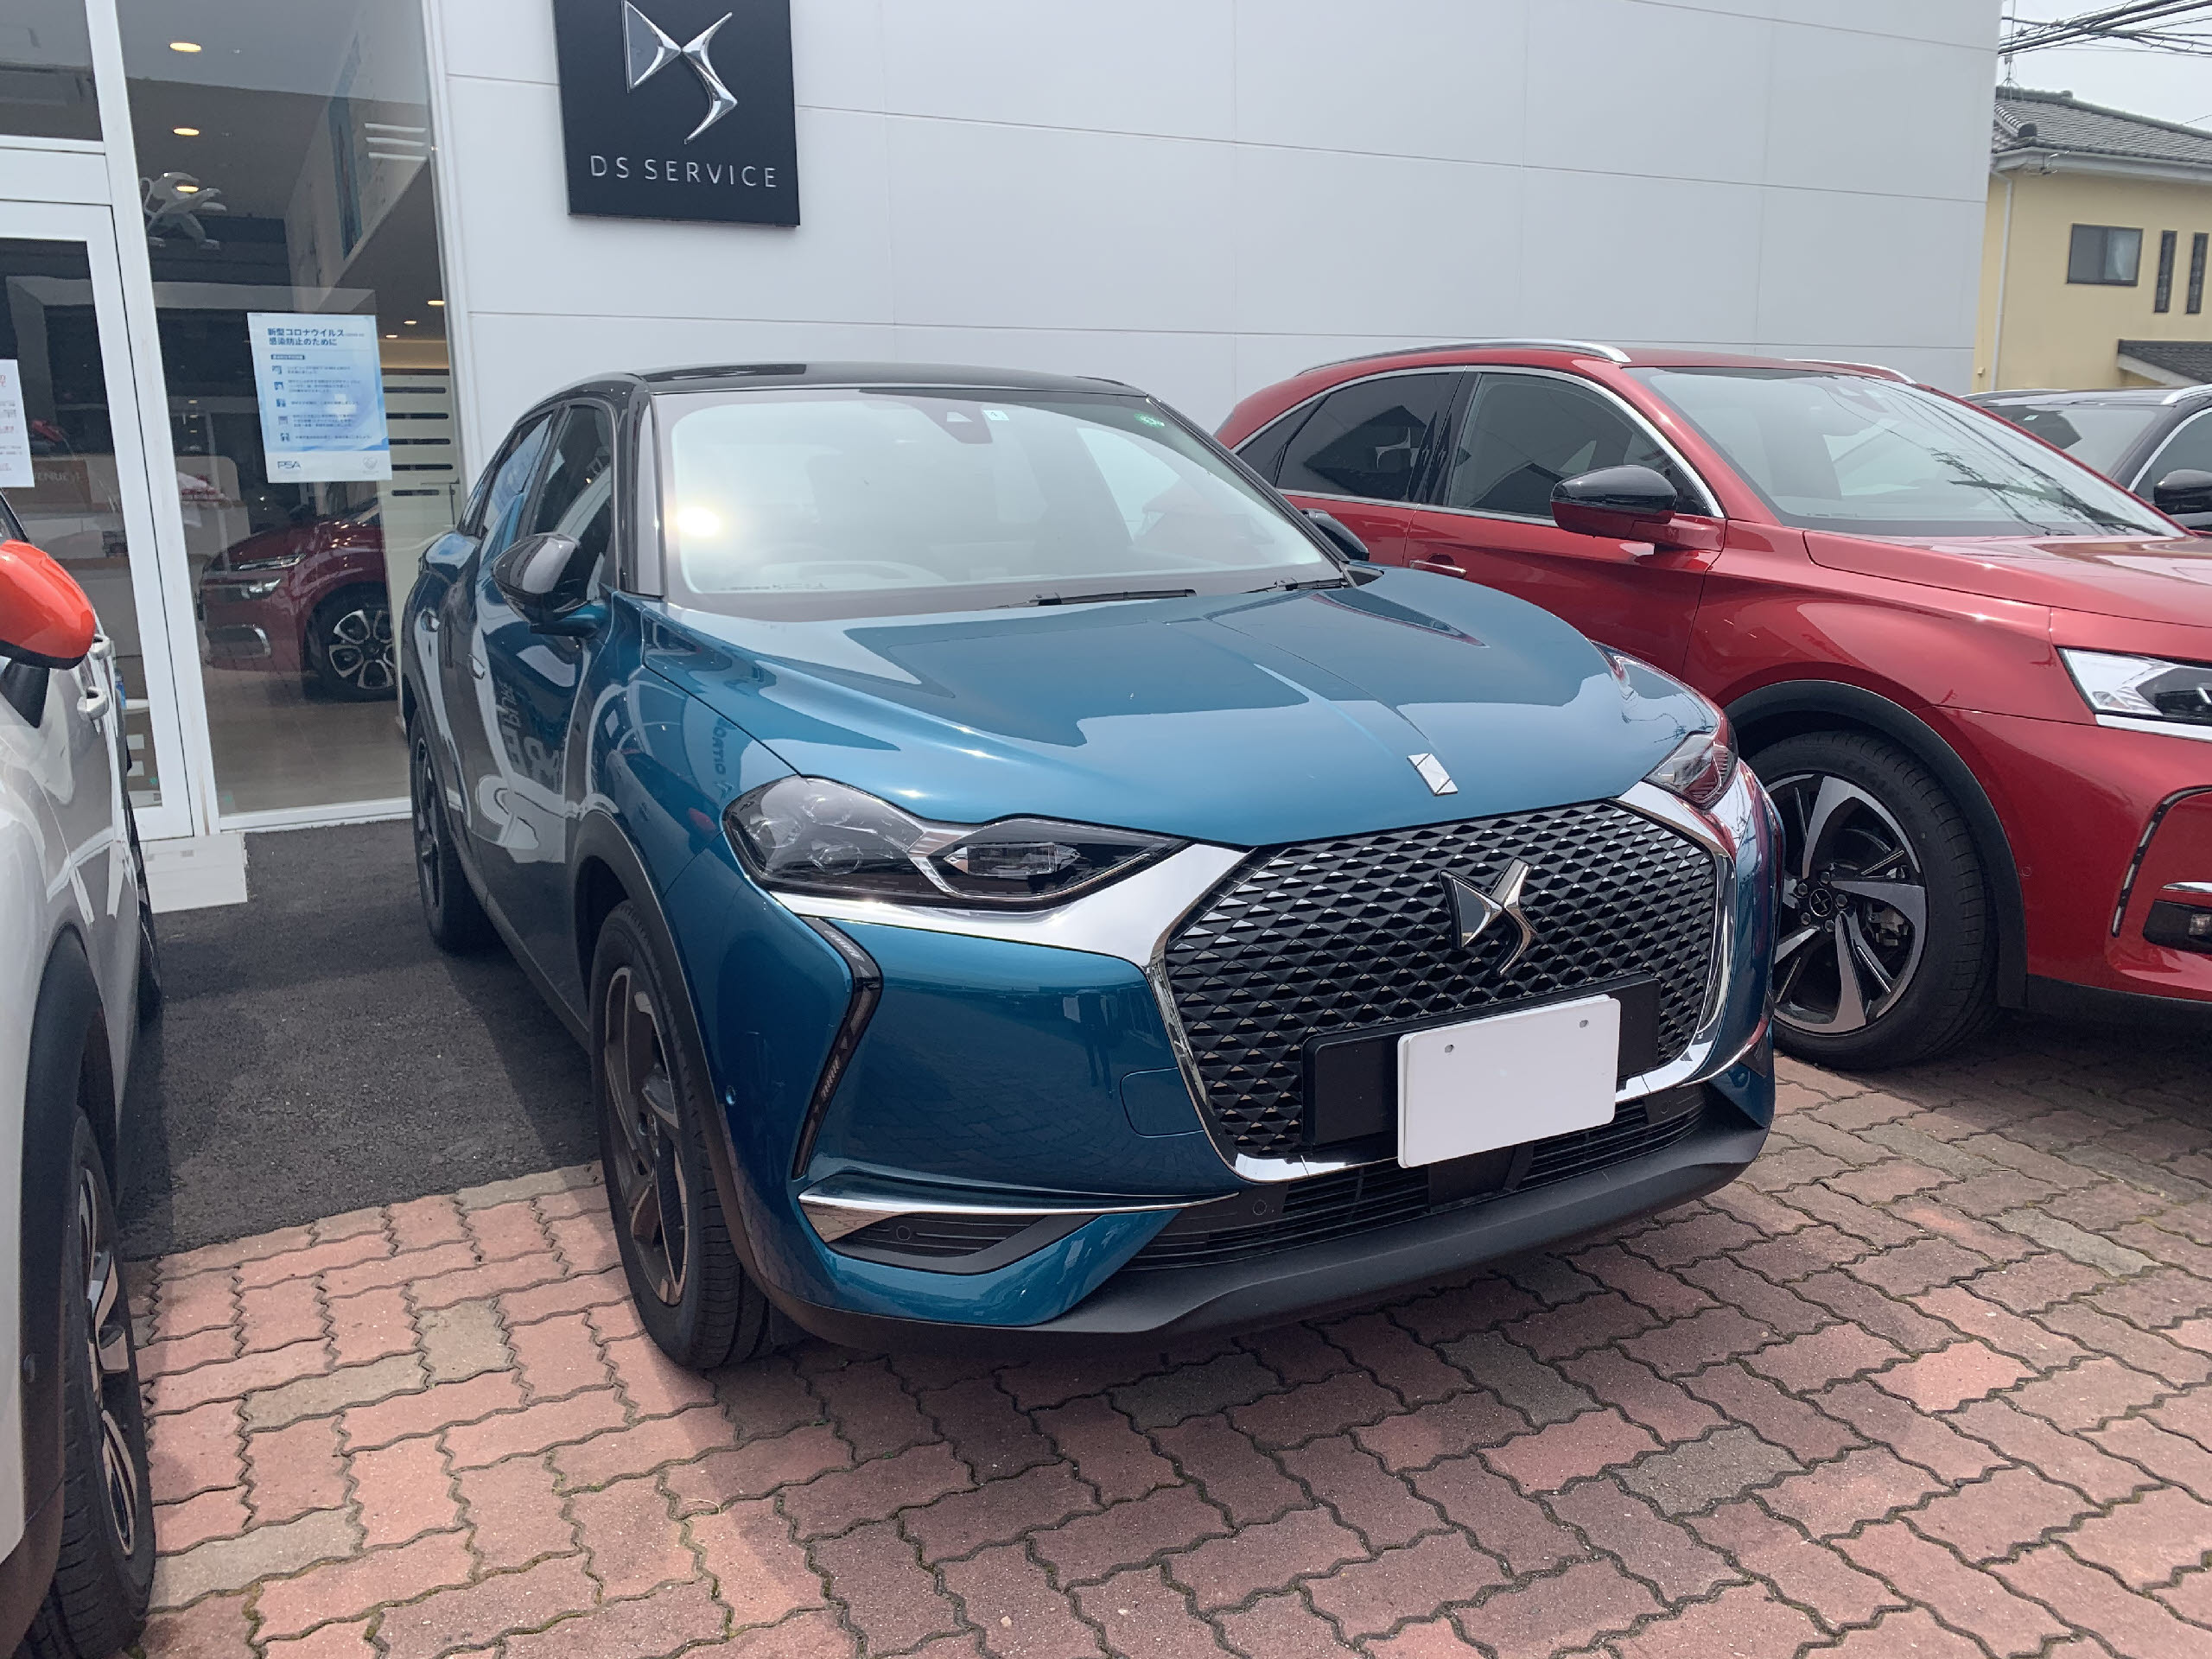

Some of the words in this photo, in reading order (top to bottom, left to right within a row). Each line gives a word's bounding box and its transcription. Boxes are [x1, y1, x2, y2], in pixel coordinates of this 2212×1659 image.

[590, 155, 630, 179] DS
[645, 159, 777, 188] SERVICE
[267, 327, 344, 337] 新型コロナウイルス
[269, 337, 337, 346] 感染防止のために
[277, 461, 301, 469] PSA
